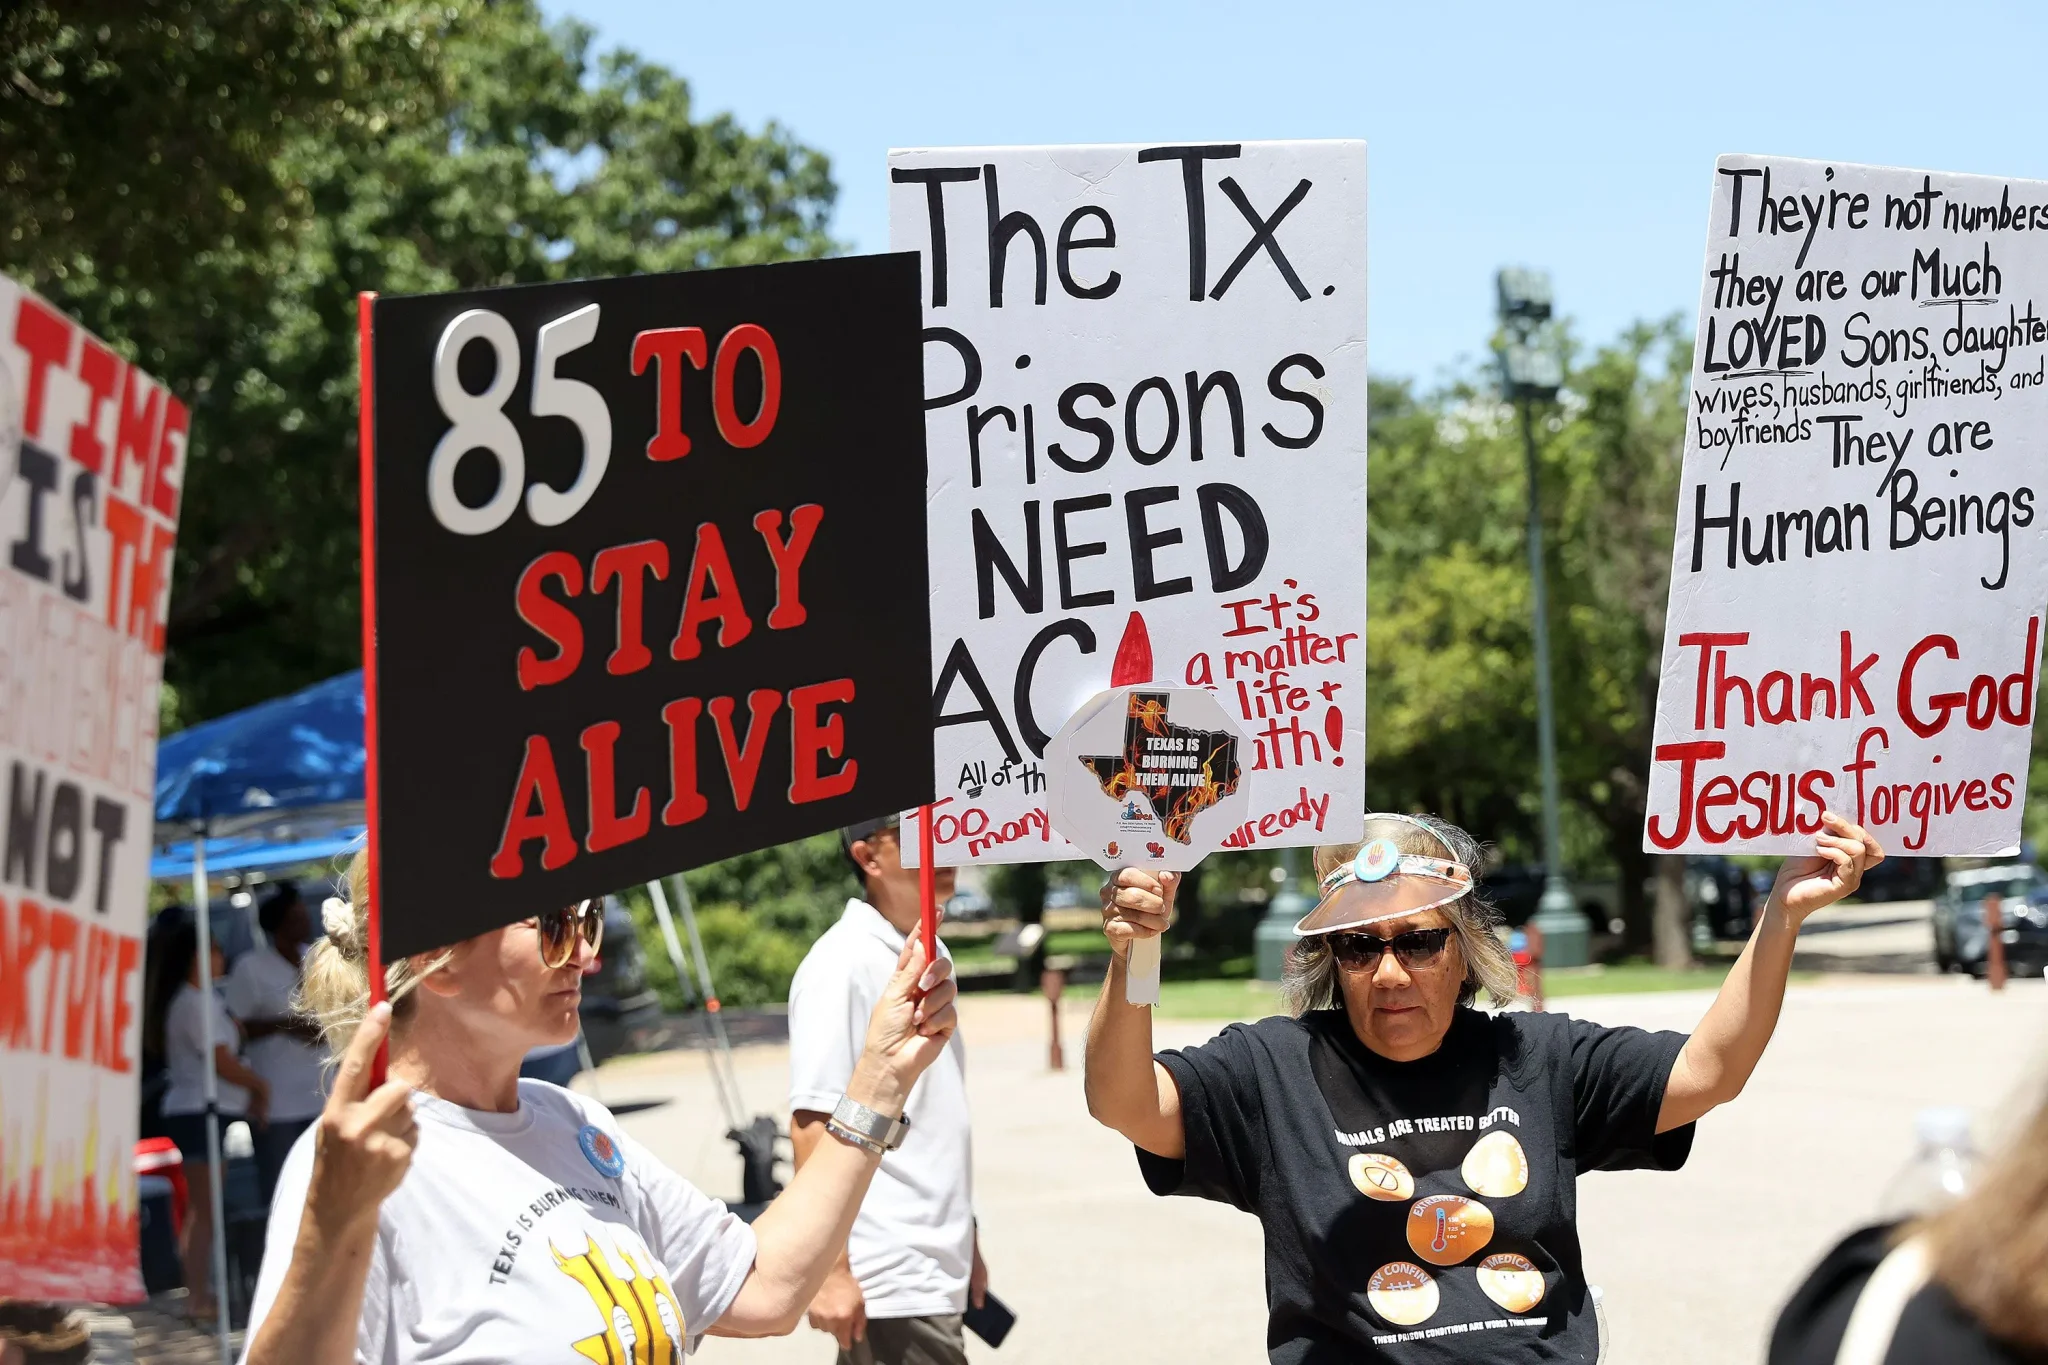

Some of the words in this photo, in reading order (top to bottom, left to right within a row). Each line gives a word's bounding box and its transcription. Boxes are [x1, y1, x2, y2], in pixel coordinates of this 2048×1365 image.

[891, 163, 1121, 309] The
[1138, 144, 1336, 302] Tx.
[1718, 166, 1870, 270] They're
[1885, 175, 1943, 230] not
[1710, 252, 1783, 331] they
[1796, 269, 1847, 302] are
[1861, 270, 1907, 300] our
[1911, 241, 2002, 301] Much
[1703, 314, 1826, 374] LOVED
[1943, 299, 2048, 374] daughte
[14, 294, 192, 522] TIME
[428, 303, 612, 536] 85
[631, 323, 781, 462] TO
[923, 327, 1325, 488] Prisons
[1695, 382, 1781, 419] wives,
[1782, 367, 1892, 410] husbands,
[1896, 359, 2004, 418] girlfriends,
[2010, 355, 2045, 391] and
[1697, 406, 1813, 471] boyfriends
[1816, 415, 1914, 498] They
[1928, 419, 1994, 457] are
[10, 438, 97, 605] IS
[971, 483, 1270, 619] NEED
[1691, 482, 1869, 572] Human
[1890, 468, 2035, 591] Beings
[516, 504, 824, 691] STAY
[1221, 578, 1320, 637] It's
[1185, 652, 1214, 686] a
[1224, 625, 1358, 679] matter
[1237, 671, 1311, 721] life
[1678, 630, 1880, 731] Thank
[1897, 616, 2039, 738] God
[490, 679, 857, 879] ALIVE
[958, 760, 988, 790] All
[992, 757, 1012, 787] of
[1135, 772, 1169, 786] THEM
[1171, 773, 1206, 787] ALIVE
[1142, 755, 1198, 769] BURNING
[1146, 737, 1184, 751] TEXAS
[1186, 738, 1200, 752] IS
[1647, 741, 1836, 850] Jesus
[1843, 726, 2015, 851] forgives
[4, 760, 127, 915] NOT
[1388, 1119, 1414, 1140] ARE
[1414, 1115, 1474, 1134] TREATED
[1383, 1263, 1430, 1287] CONFIN
